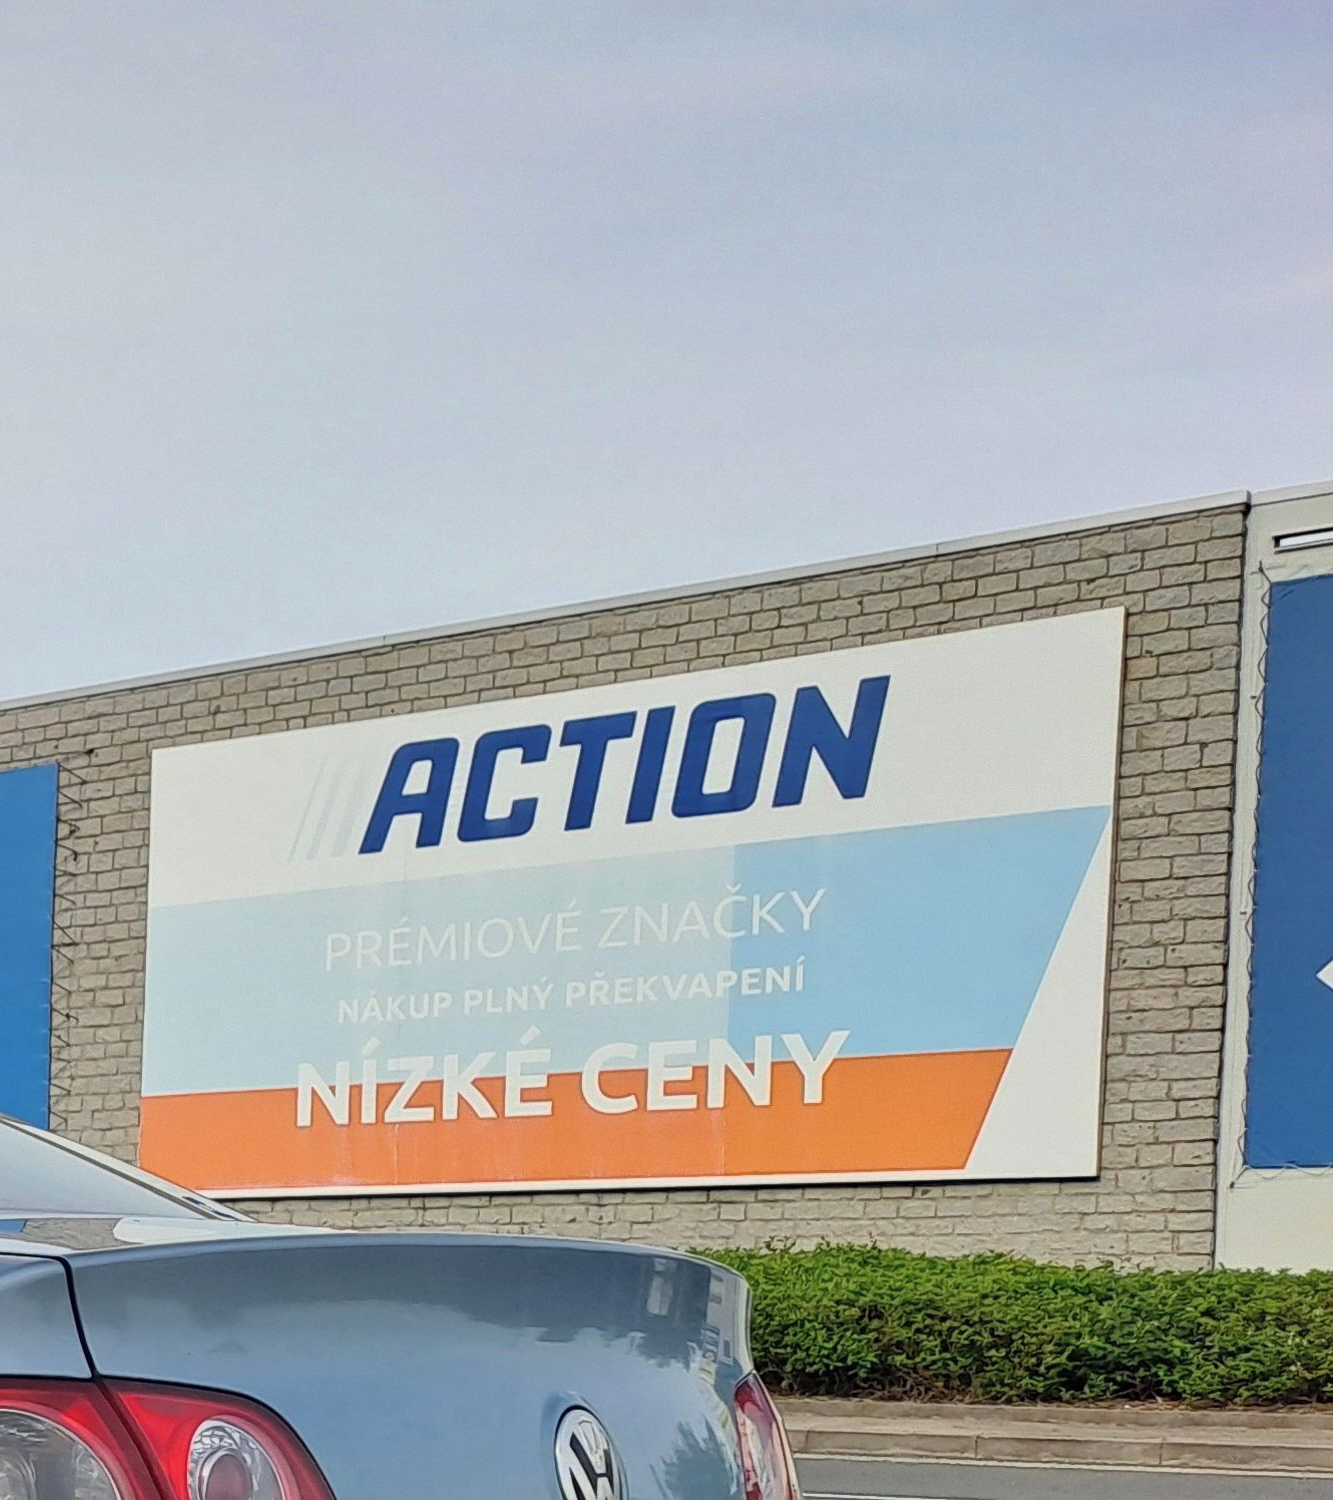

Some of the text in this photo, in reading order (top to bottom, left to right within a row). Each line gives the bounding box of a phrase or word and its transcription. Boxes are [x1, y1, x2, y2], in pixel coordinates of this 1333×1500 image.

[357, 674, 892, 856] ACTION
[325, 882, 827, 972] PRÉMIOVÉ ZNAČKY
[338, 955, 806, 1025] NÁKUP PLNÝ PŘEKVAPENÍ
[294, 1024, 852, 1128] NÍZKÉ CENY
